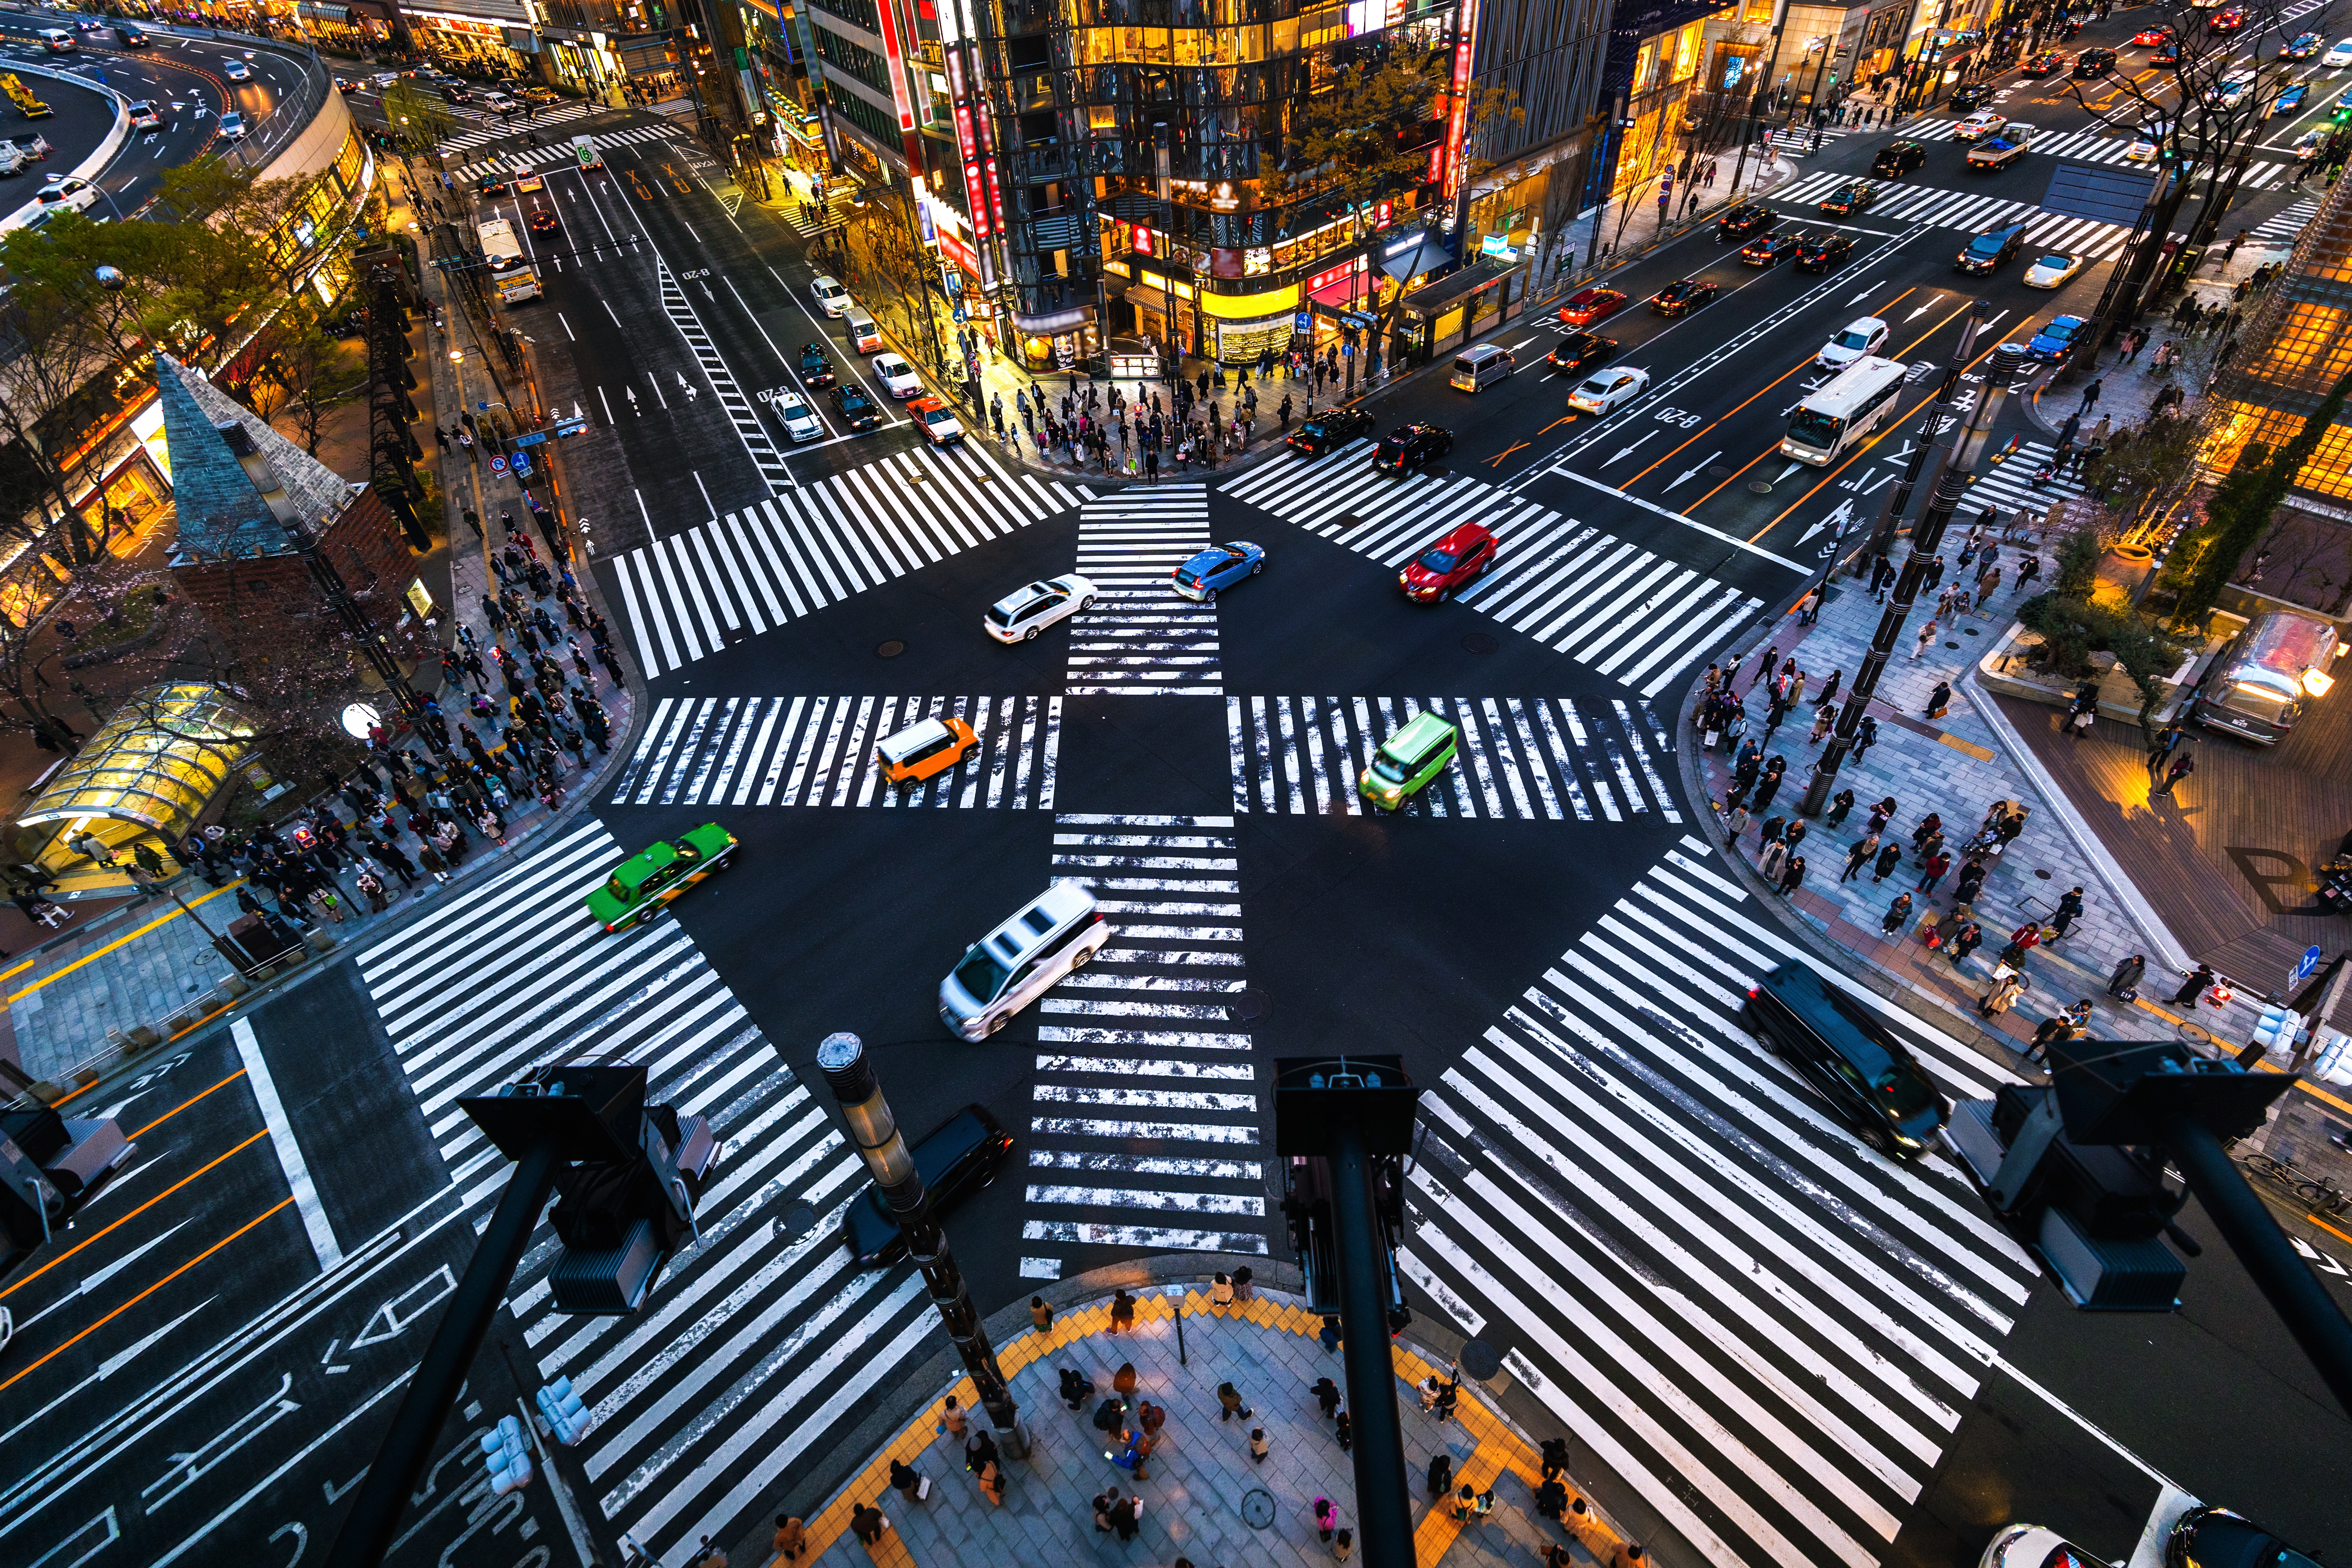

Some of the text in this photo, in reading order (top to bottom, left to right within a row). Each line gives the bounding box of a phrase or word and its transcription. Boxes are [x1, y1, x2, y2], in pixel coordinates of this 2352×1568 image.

[682, 268, 710, 280] 8-20
[1530, 316, 1583, 335] 17-19
[1654, 407, 1702, 428] 8-20
